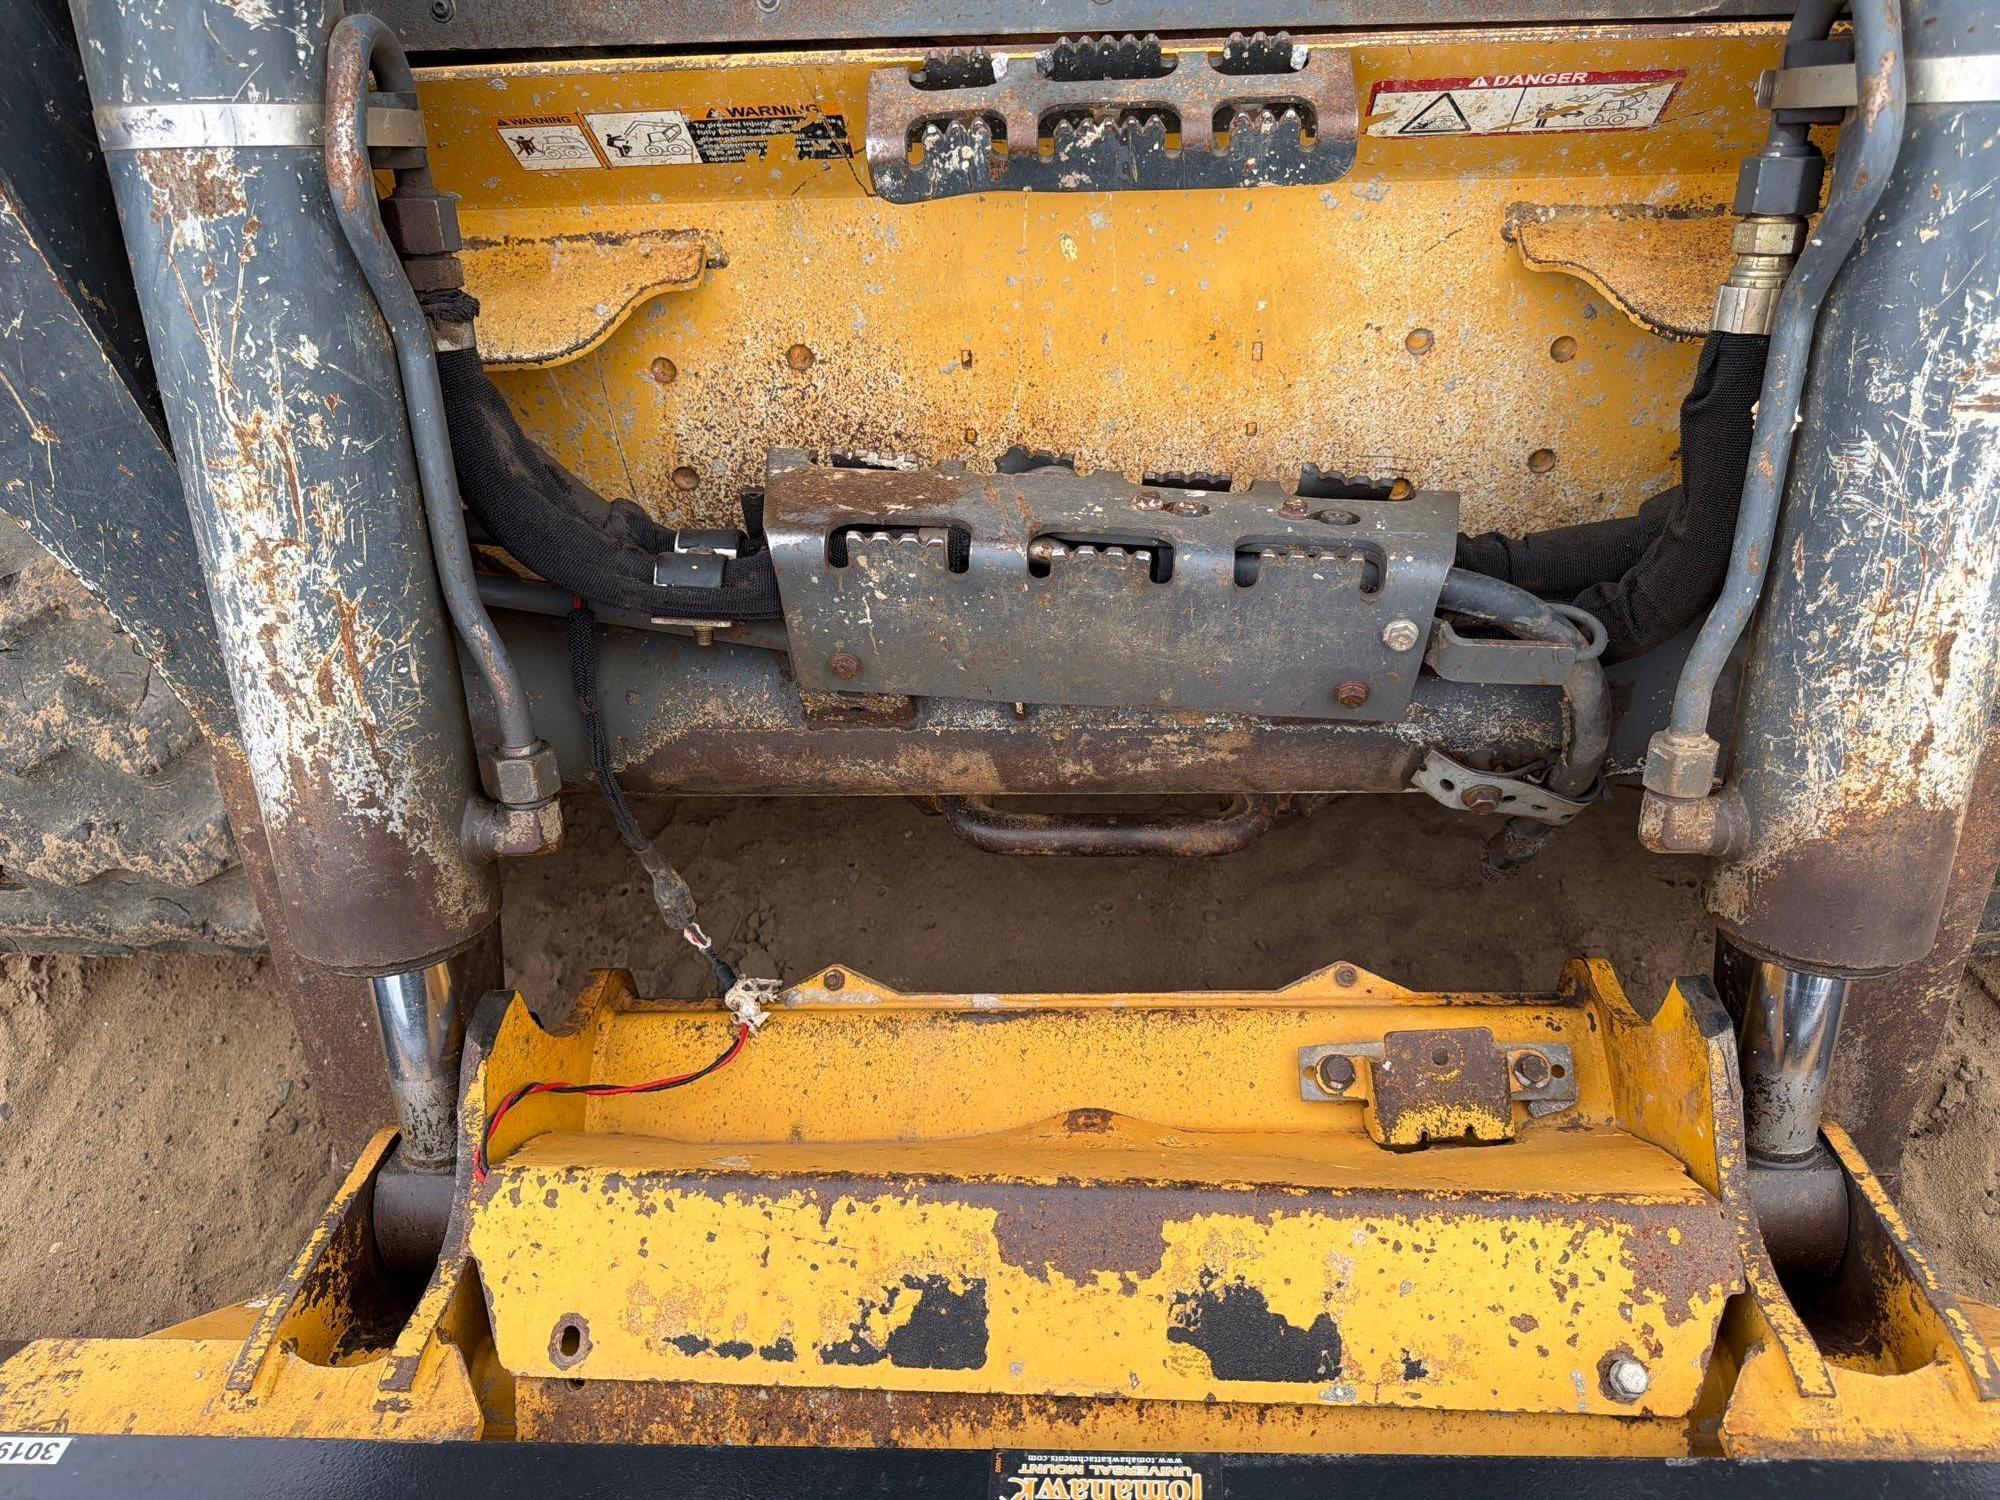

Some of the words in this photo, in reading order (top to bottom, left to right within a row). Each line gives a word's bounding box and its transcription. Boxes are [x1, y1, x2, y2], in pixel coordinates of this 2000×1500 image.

[1493, 72, 1588, 86] DANGER
[510, 116, 571, 126] WARNING
[707, 121, 741, 130] prevent
[1028, 1455, 1182, 1464] www.tomahawkattachments.com
[1018, 1464, 1084, 1476] MOUNT
[1089, 1465, 1192, 1477] UNIVERSAL
